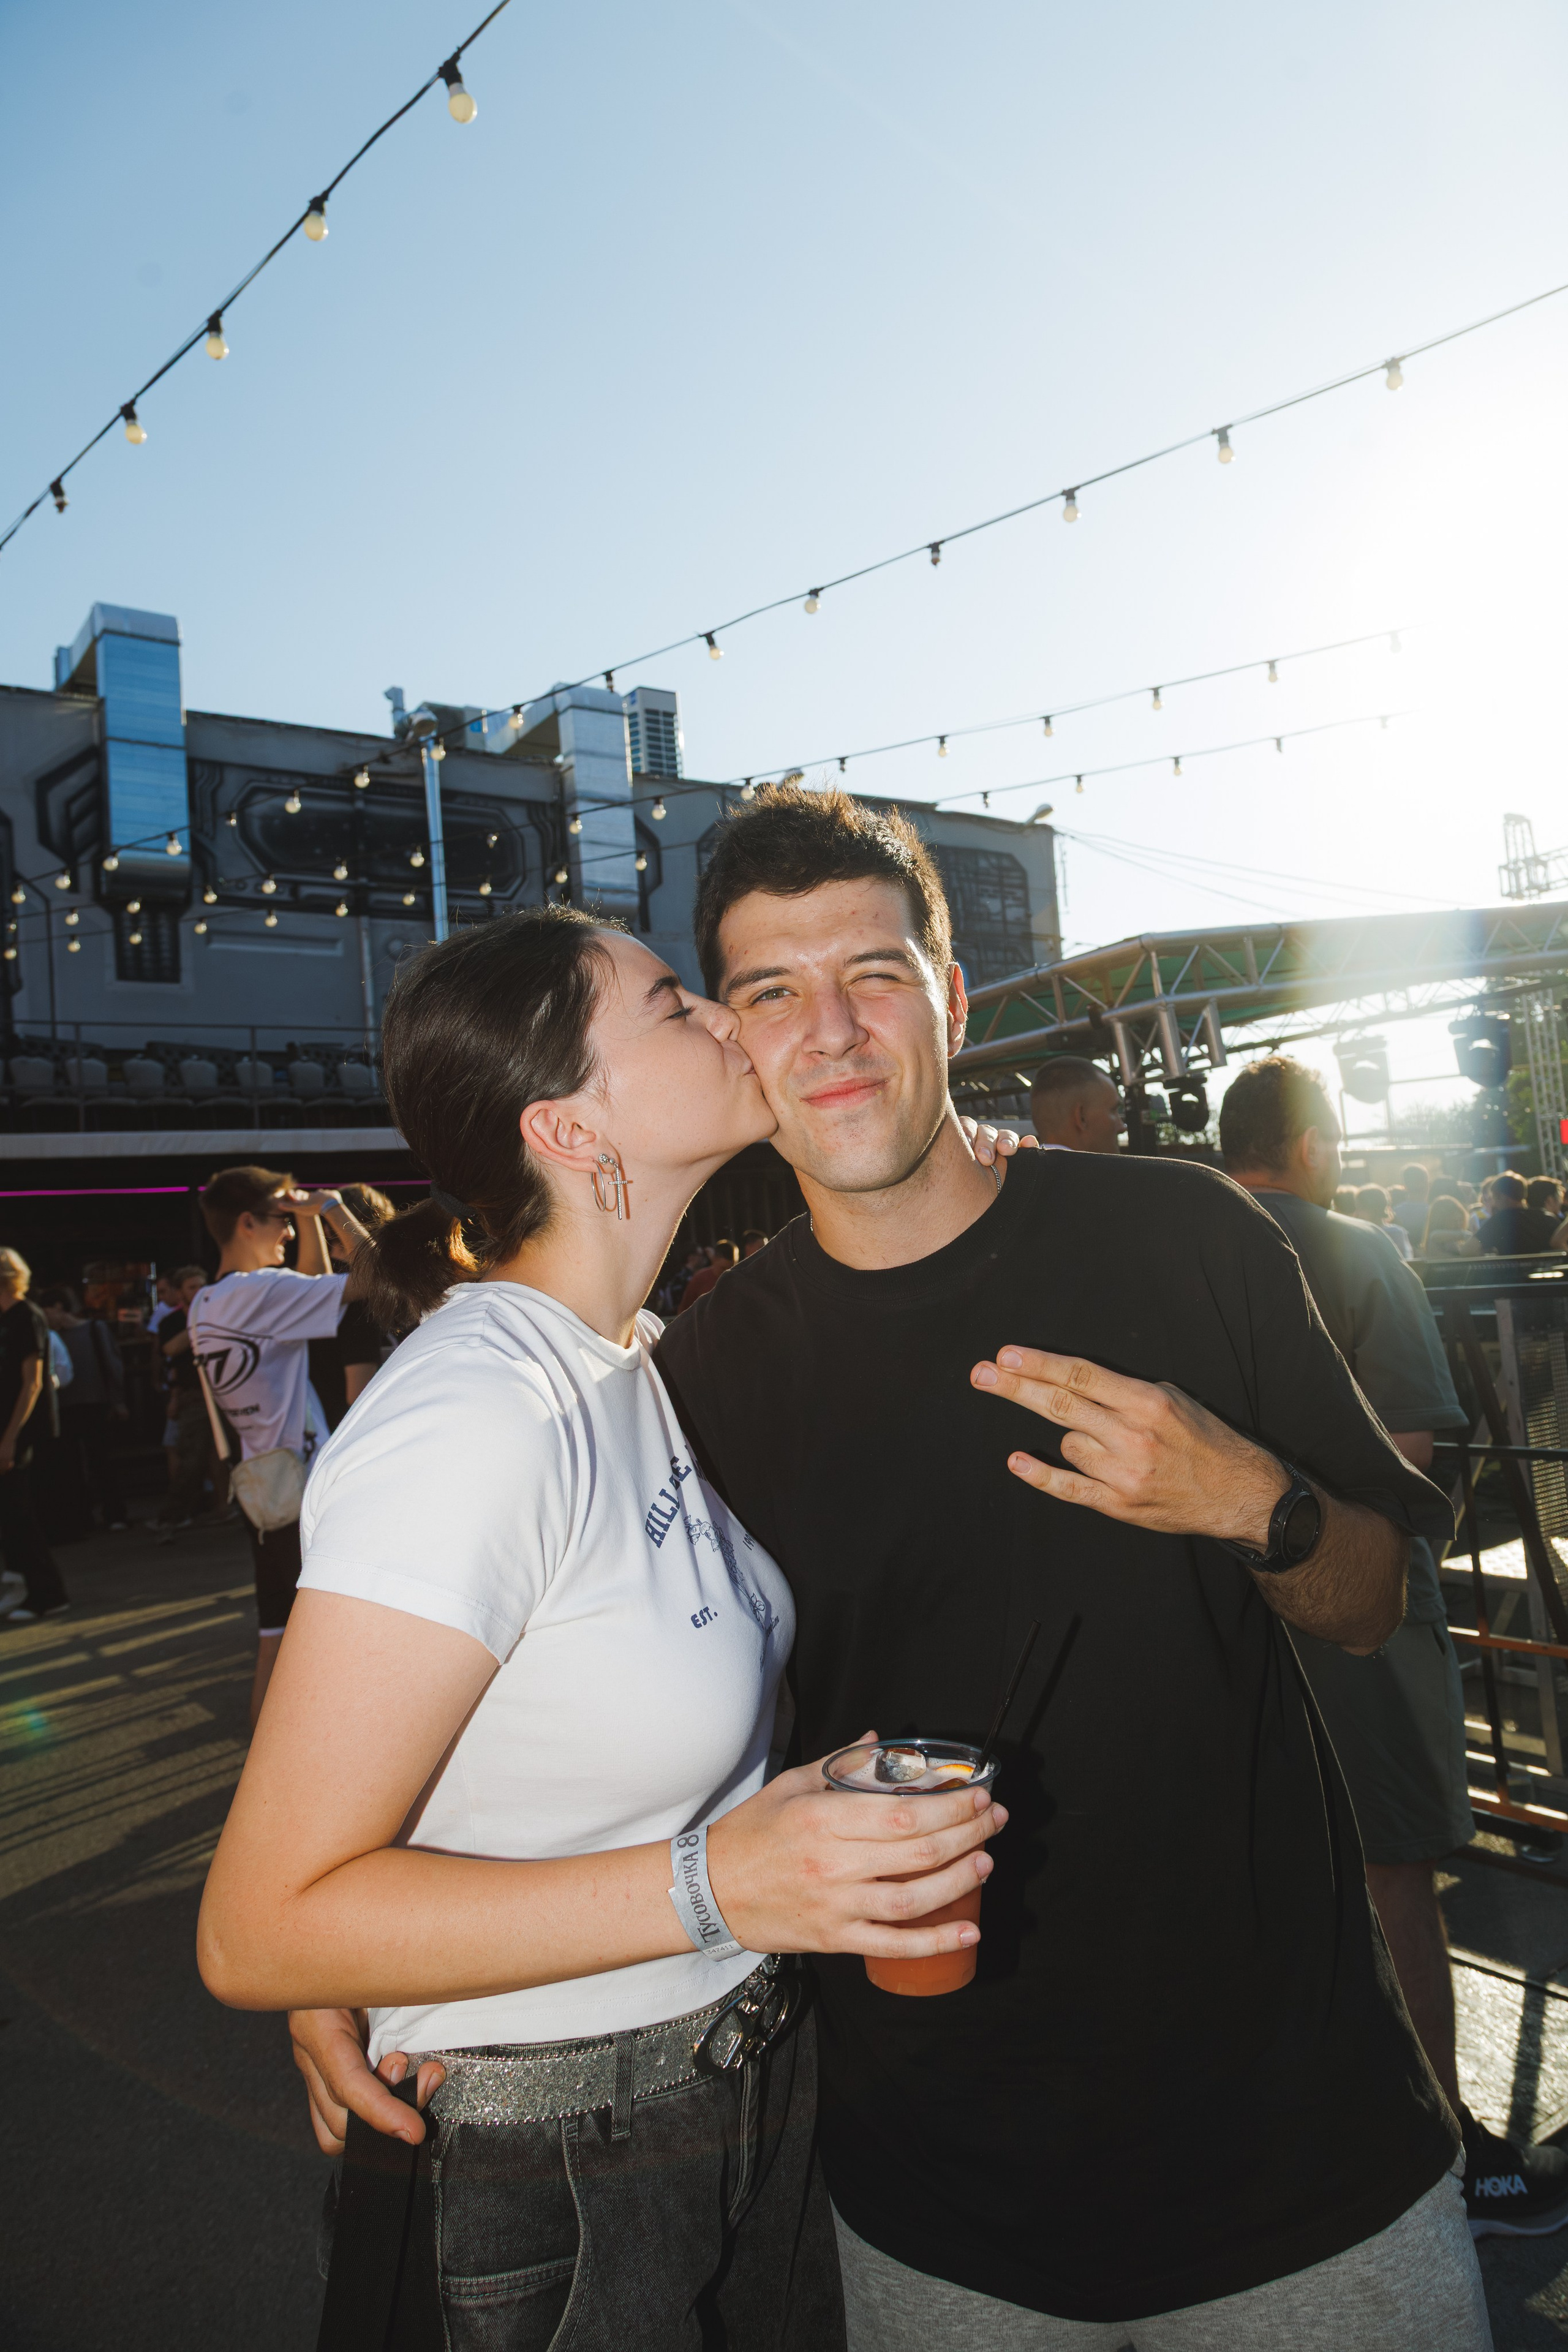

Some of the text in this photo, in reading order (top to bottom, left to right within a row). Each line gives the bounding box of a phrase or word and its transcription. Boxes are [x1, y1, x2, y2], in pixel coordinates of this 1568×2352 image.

[690, 1606, 718, 1629] EST.
[677, 1834, 699, 1849] 8
[1476, 2174, 1528, 2197] HOKA
